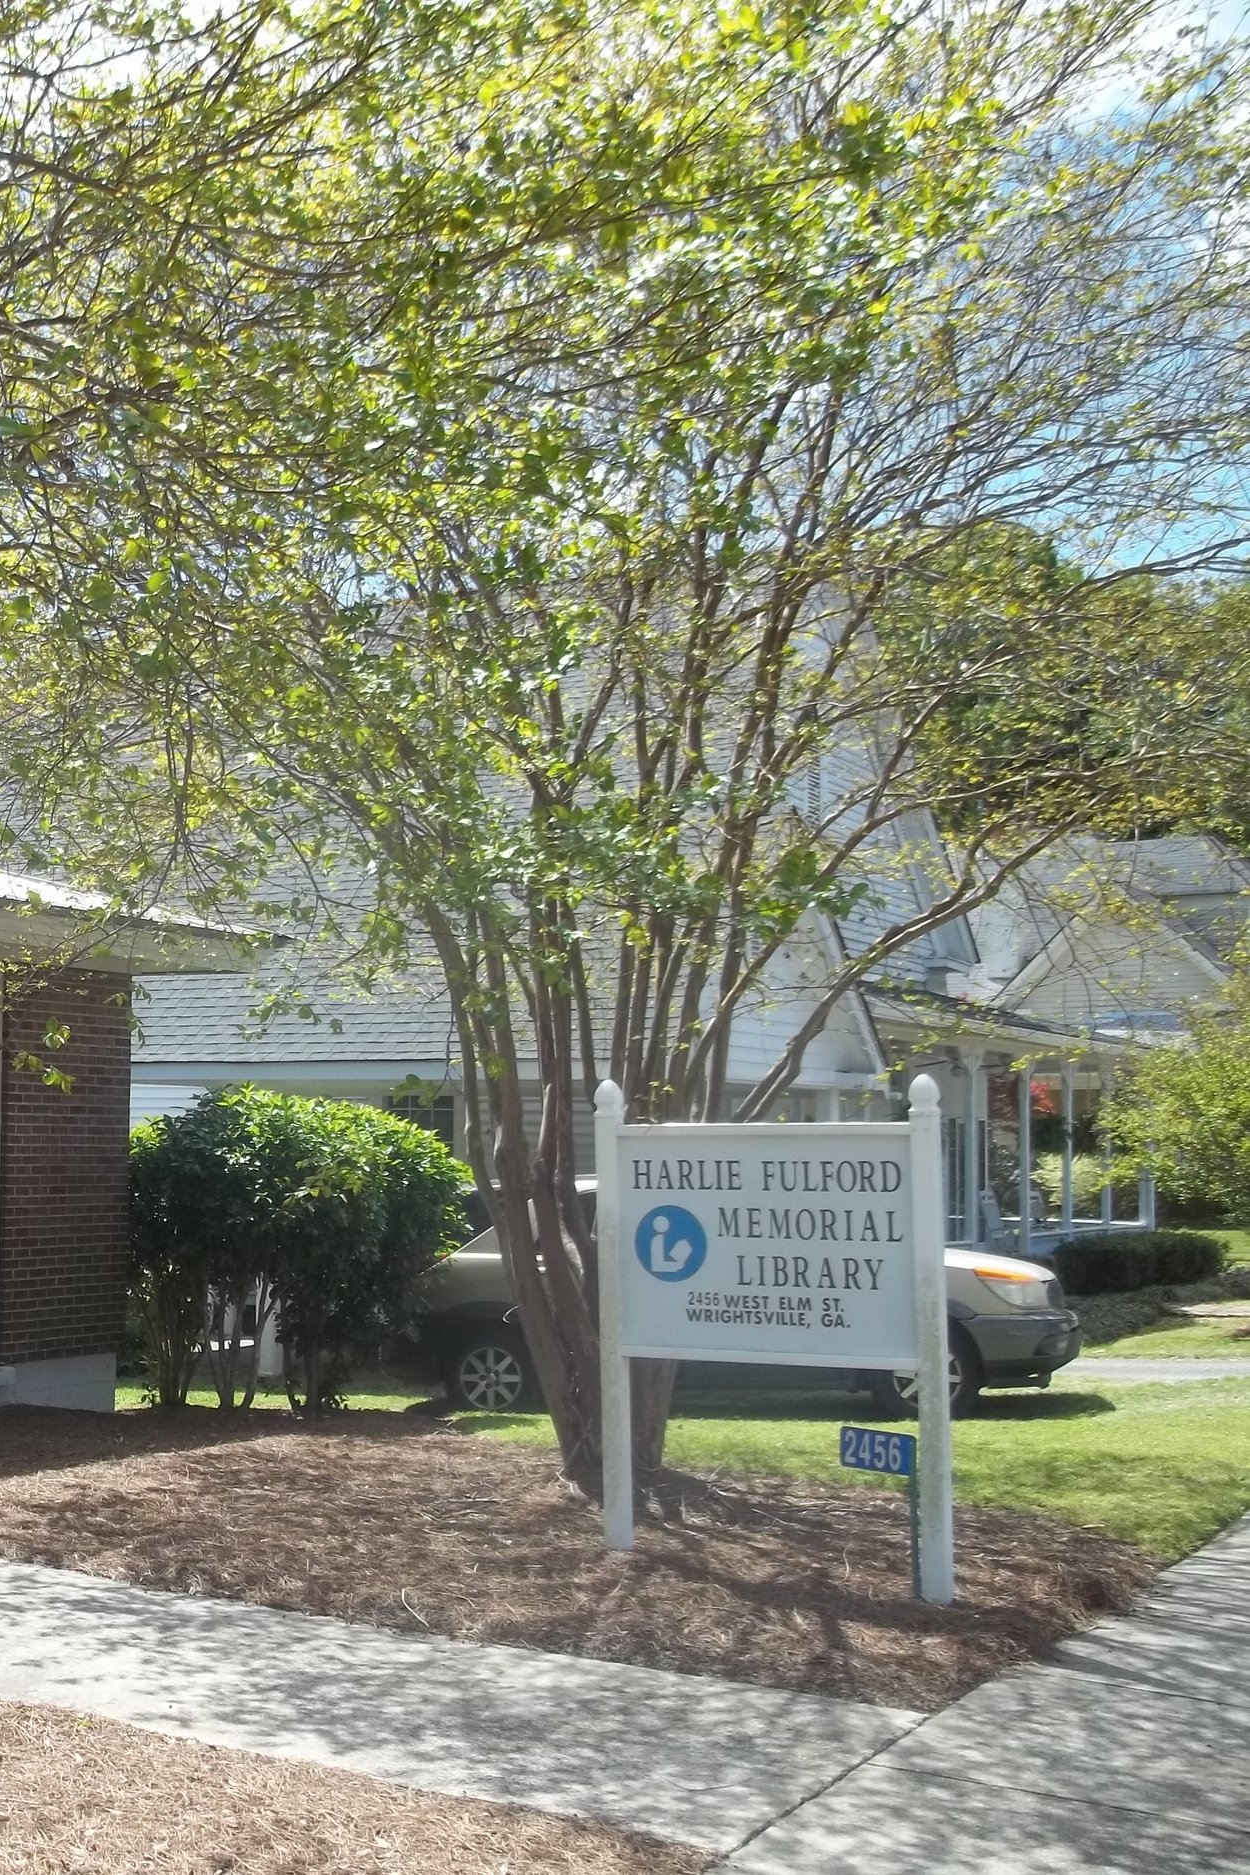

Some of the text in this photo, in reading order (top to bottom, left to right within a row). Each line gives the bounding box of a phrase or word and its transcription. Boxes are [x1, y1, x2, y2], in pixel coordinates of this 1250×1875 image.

[631, 1158, 902, 1193] HARLIE FULFORD
[716, 1206, 903, 1243] MEMORIAL
[736, 1254, 885, 1291] LIBRARY
[685, 1308, 851, 1329] WRIGHTSVILLE, GA.
[687, 1291, 845, 1313] 2456 WEST ELM ST.
[844, 1429, 902, 1471] 2456
